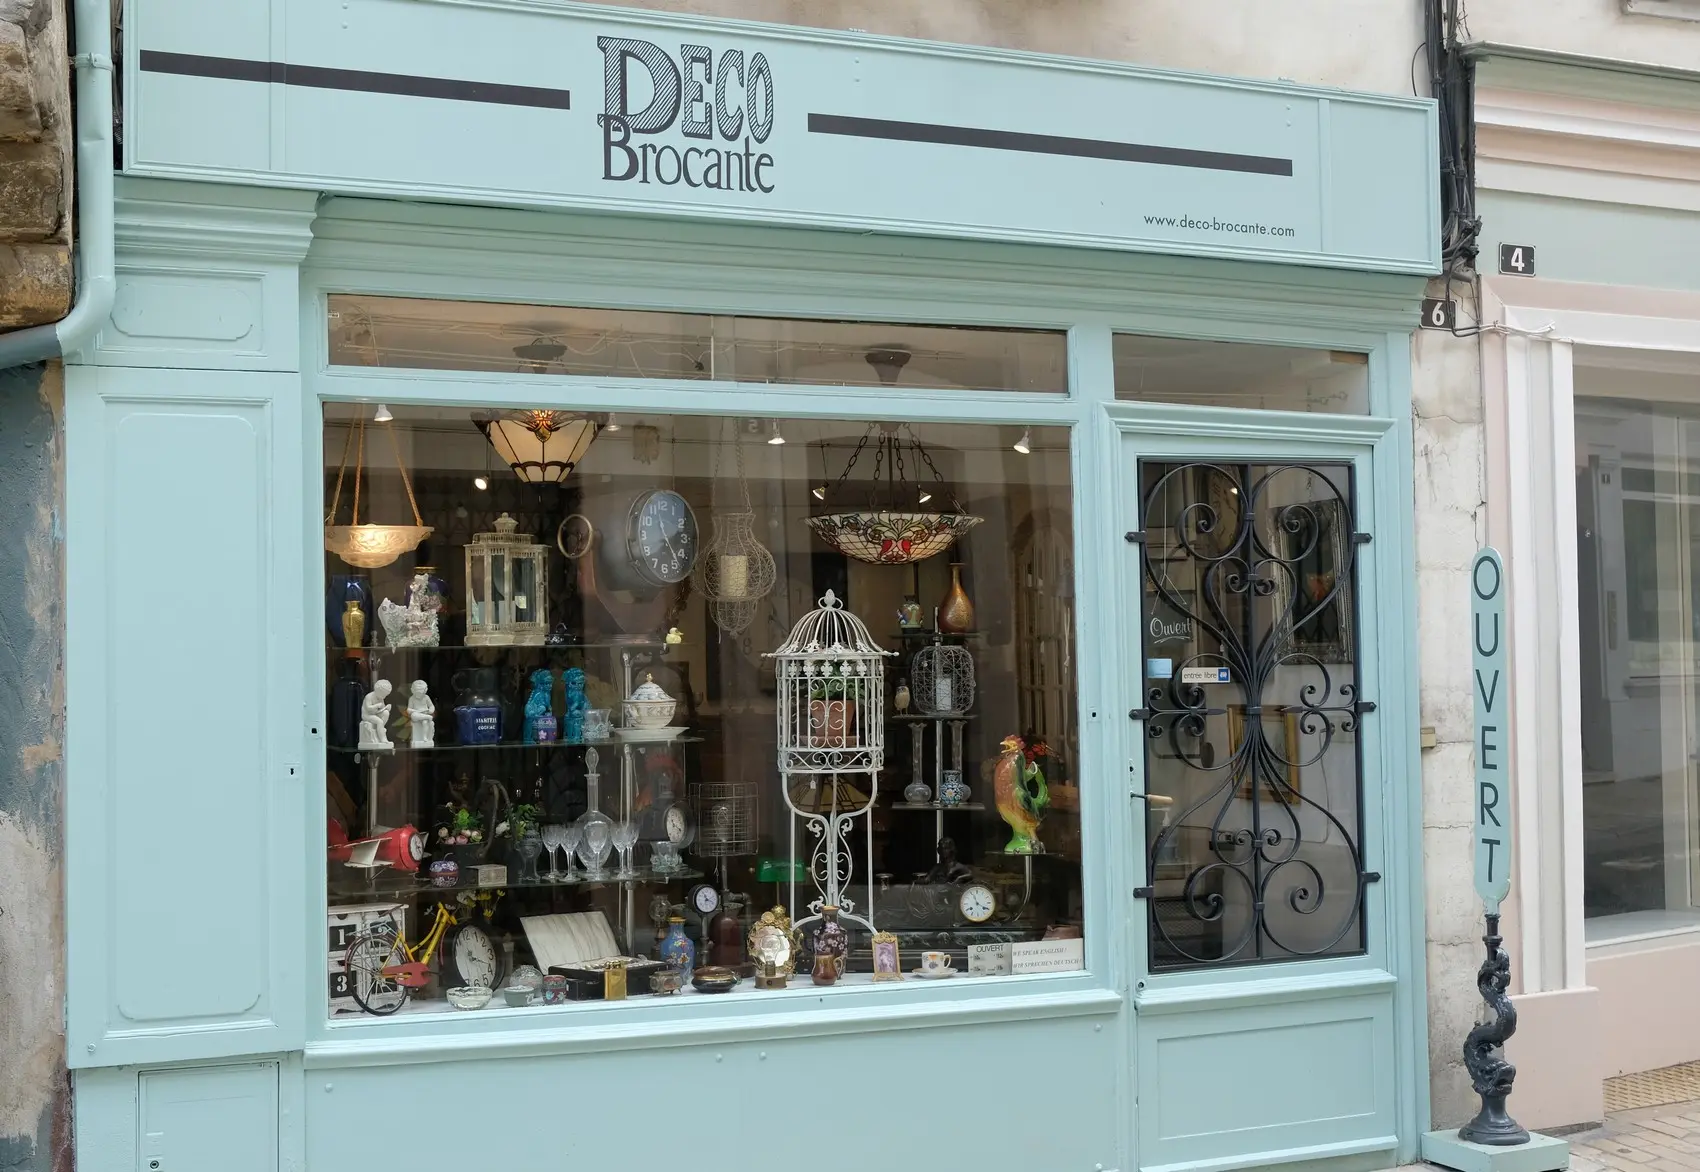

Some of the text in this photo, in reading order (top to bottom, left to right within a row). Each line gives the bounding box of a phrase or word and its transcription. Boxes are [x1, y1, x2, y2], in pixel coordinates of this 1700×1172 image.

[597, 35, 774, 144] DECO
[602, 114, 775, 193] Brocante
[1144, 214, 1295, 237] www.deco-brocante.com
[1511, 247, 1525, 272] 4
[1432, 302, 1445, 326] 6
[649, 505, 657, 515] 11
[657, 501, 668, 511] 12
[642, 516, 652, 527] 10
[677, 518, 685, 529] 2
[680, 533, 688, 544] 3
[677, 548, 685, 559] 4
[651, 558, 658, 568] 7
[661, 564, 668, 574] 6
[671, 560, 679, 570] 5
[1150, 617, 1191, 638] Ouvert
[1473, 555, 1502, 883] OUVERT
[338, 929, 346, 945] 1
[481, 936, 487, 947] 2
[486, 948, 494, 961] 3
[976, 944, 1004, 953] OUVERT
[487, 963, 494, 976] 4
[336, 975, 348, 992] 3
